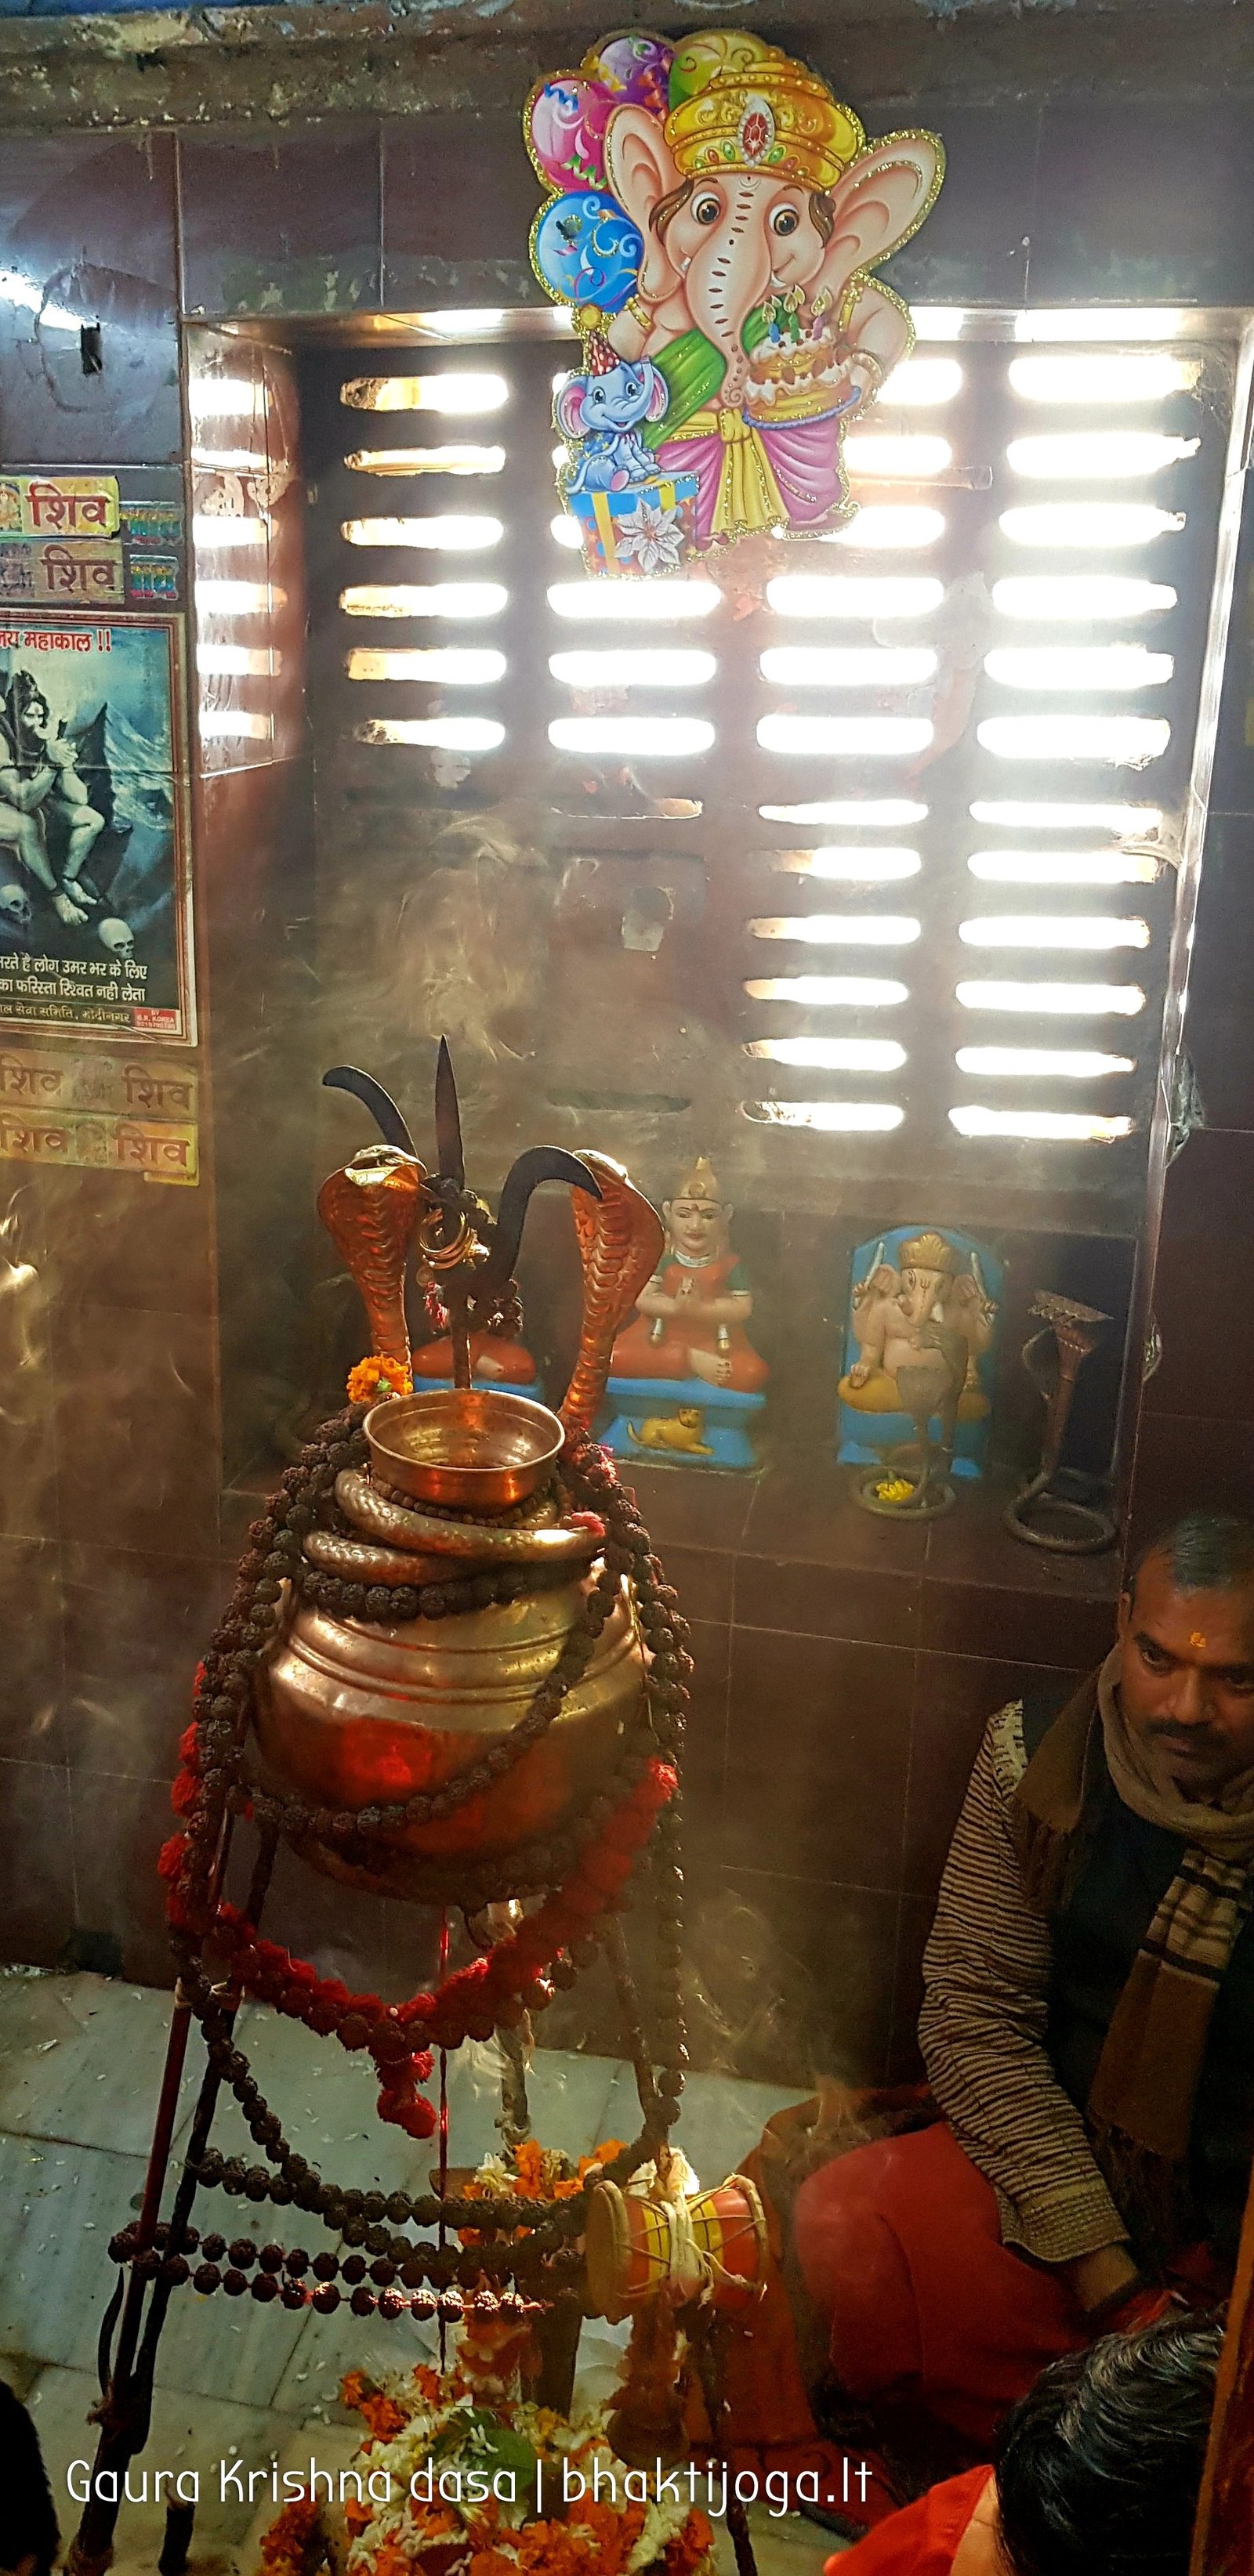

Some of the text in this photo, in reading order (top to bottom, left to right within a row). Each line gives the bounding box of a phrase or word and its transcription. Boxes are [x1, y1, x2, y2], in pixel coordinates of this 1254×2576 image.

[25, 480, 111, 529] शिव
[40, 544, 117, 593] शिव
[24, 631, 92, 652] महाकाल
[33, 953, 60, 973] लोग
[62, 959, 88, 975] उमर
[89, 961, 107, 976] भर
[108, 958, 122, 977] के
[124, 959, 148, 980] लिए
[96, 980, 119, 1000] नही
[121, 982, 146, 1002] लेता
[121, 1062, 194, 1109] शिव
[111, 1123, 190, 1167] शिव
